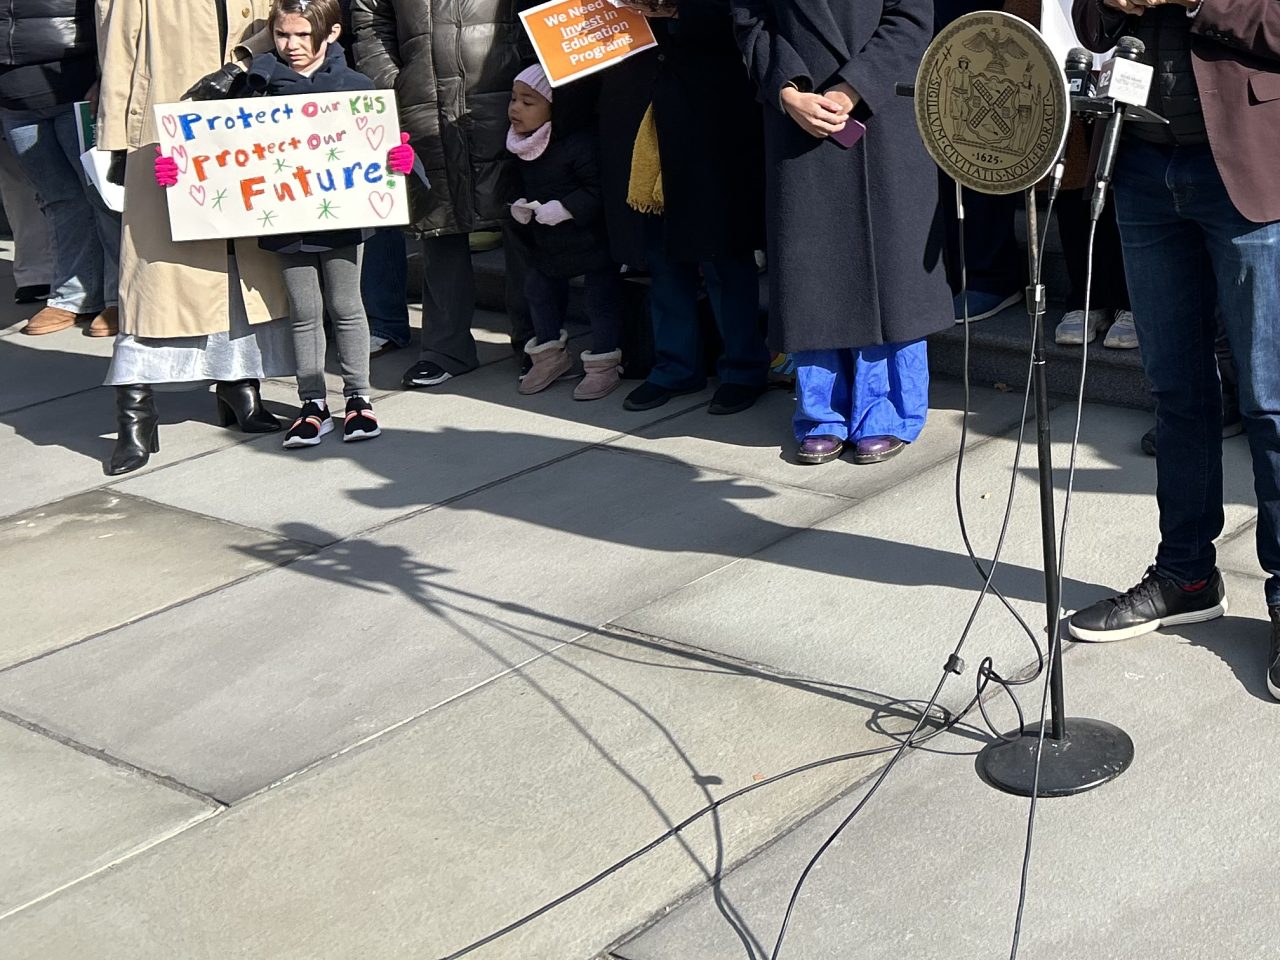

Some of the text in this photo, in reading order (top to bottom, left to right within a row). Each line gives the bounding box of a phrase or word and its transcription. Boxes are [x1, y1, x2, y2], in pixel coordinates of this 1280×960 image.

[544, 0, 604, 28] We Need
[560, 10, 618, 39] Invest in
[561, 21, 629, 53] Education
[569, 35, 634, 65] Programs
[178, 103, 294, 142] Protect
[976, 152, 1000, 164] 1625
